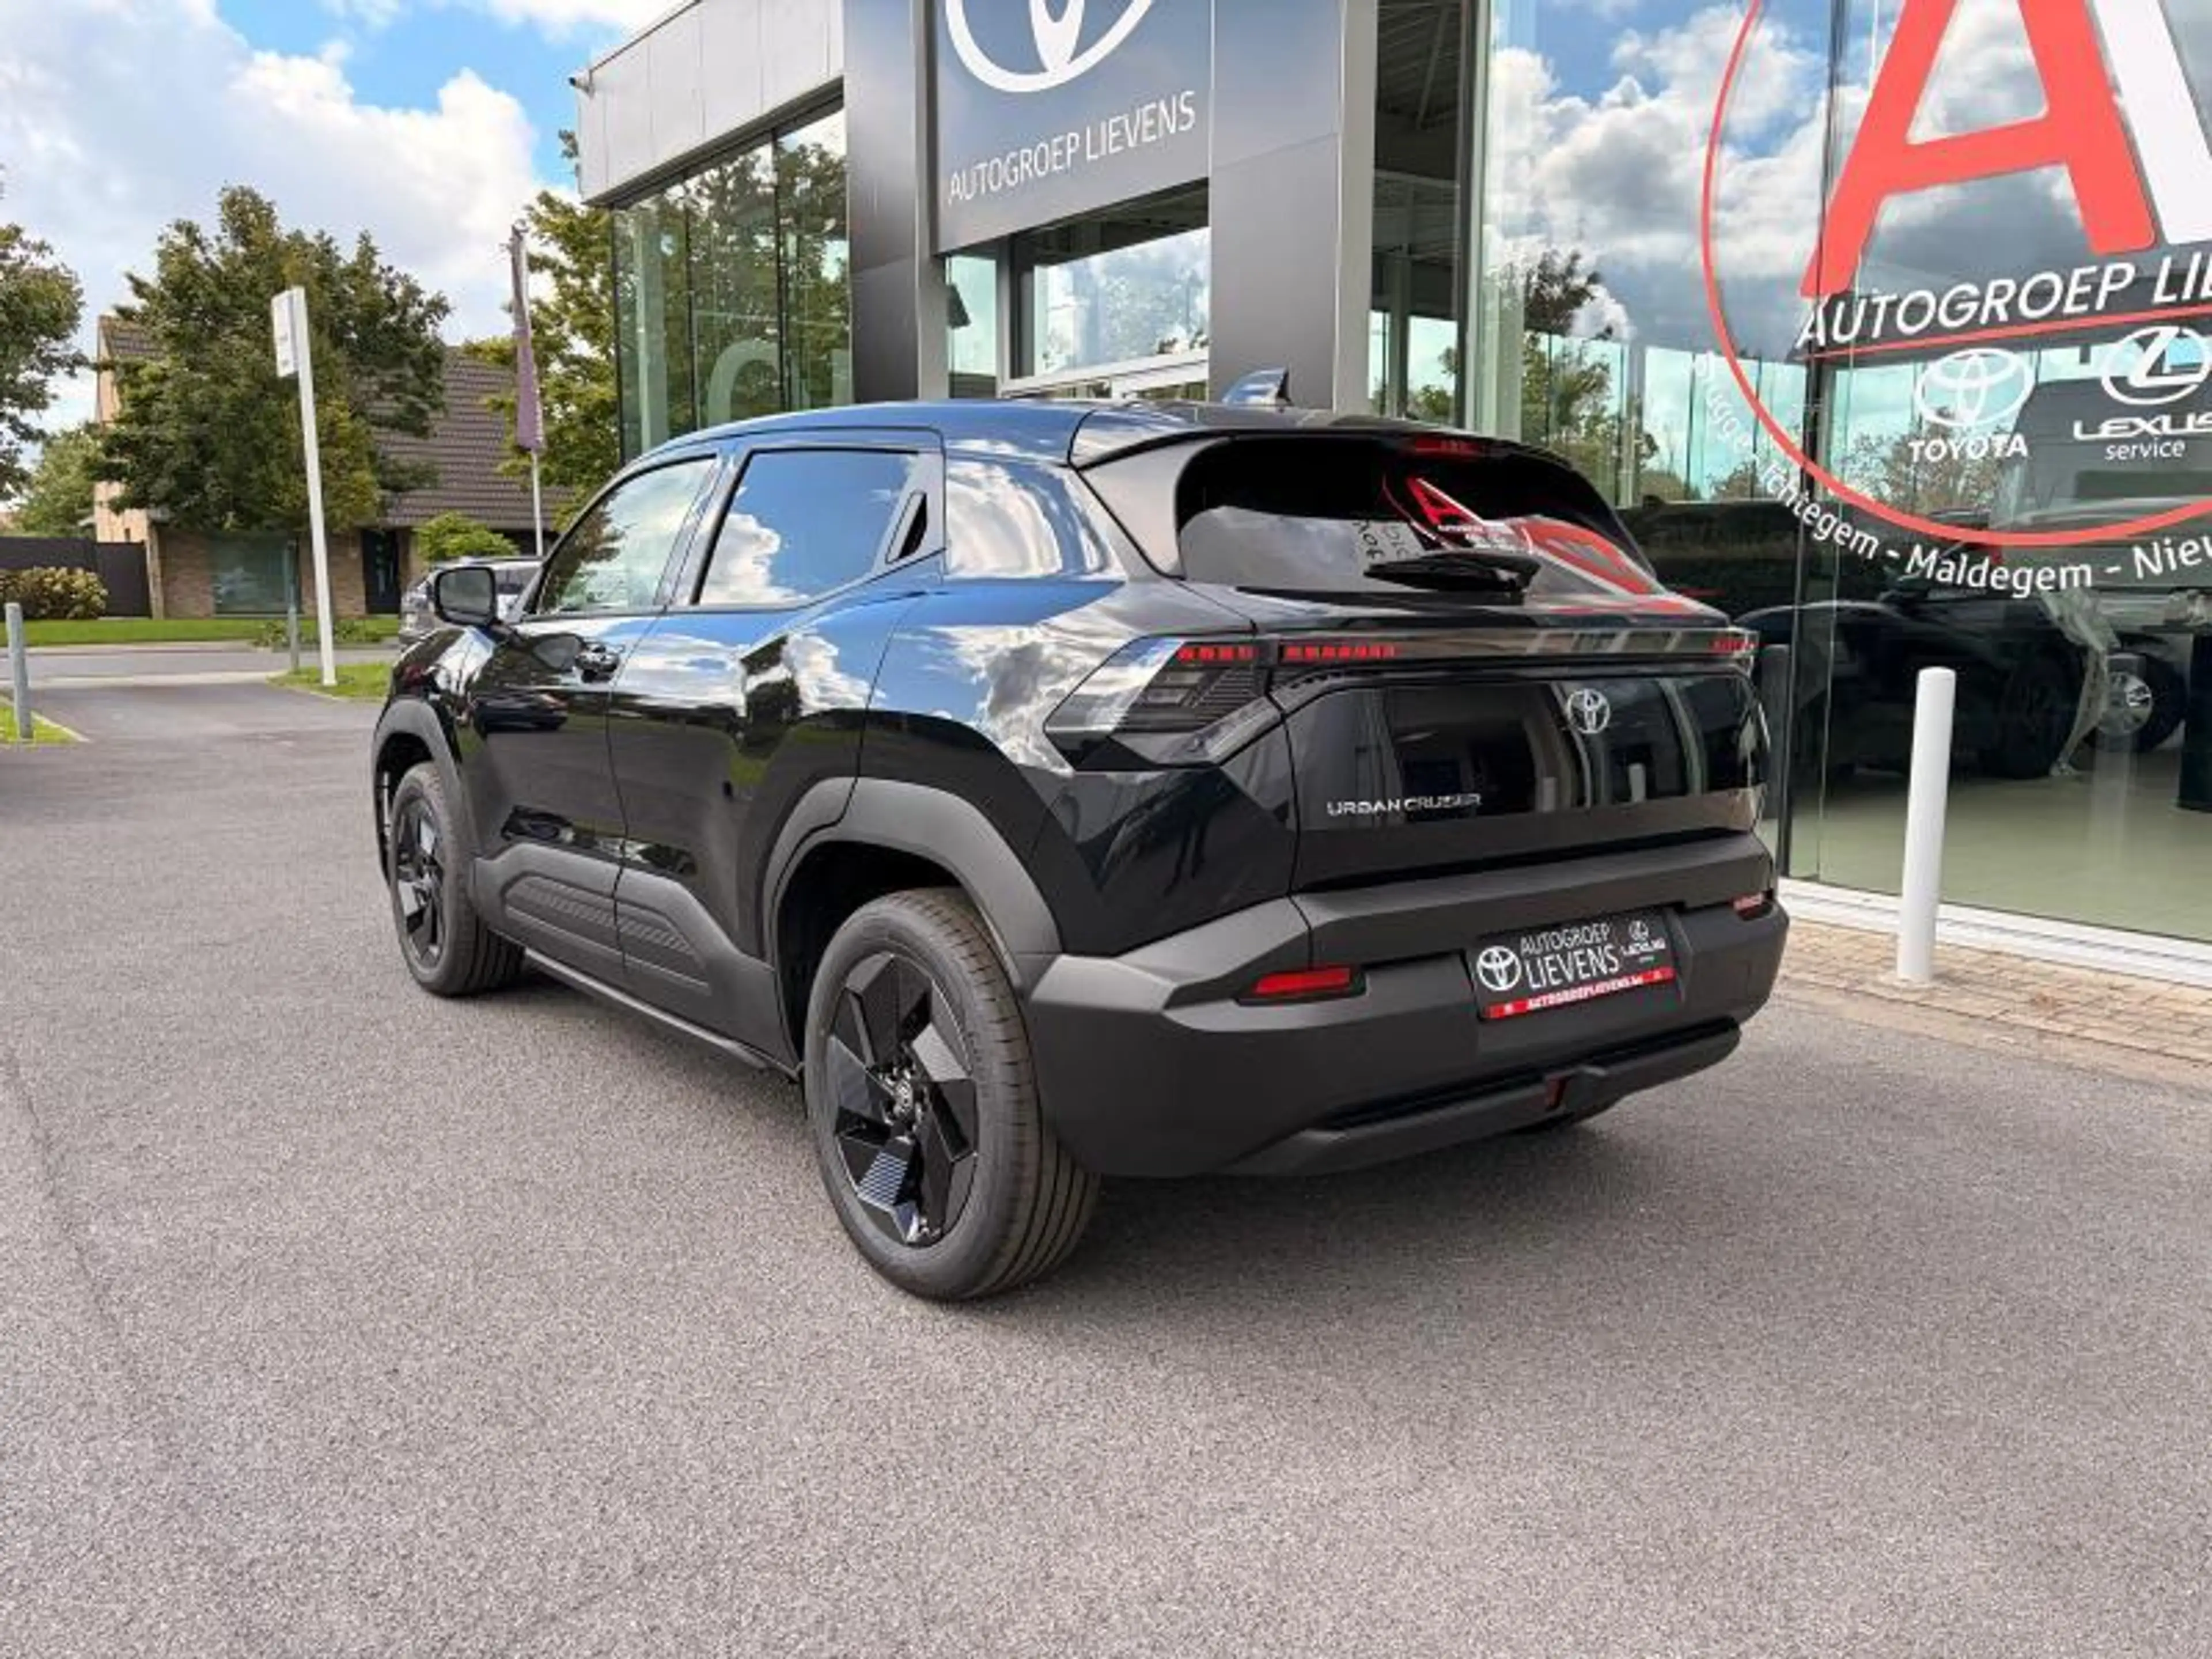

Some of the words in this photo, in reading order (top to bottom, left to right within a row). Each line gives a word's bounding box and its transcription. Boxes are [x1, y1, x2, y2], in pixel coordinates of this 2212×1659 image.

[948, 132, 1080, 204] AUTOGROEP
[1086, 90, 1196, 161] LIEVENS
[1796, 262, 2135, 347] AUTOGROEP
[1908, 433, 2029, 462] TOYOTA
[2105, 437, 2186, 461] service
[1904, 543, 2092, 599] Maldegem
[1326, 798, 1401, 817] URBAN
[1520, 923, 1610, 957] AUTOGROEP
[1524, 944, 1620, 989] LIEVENS
